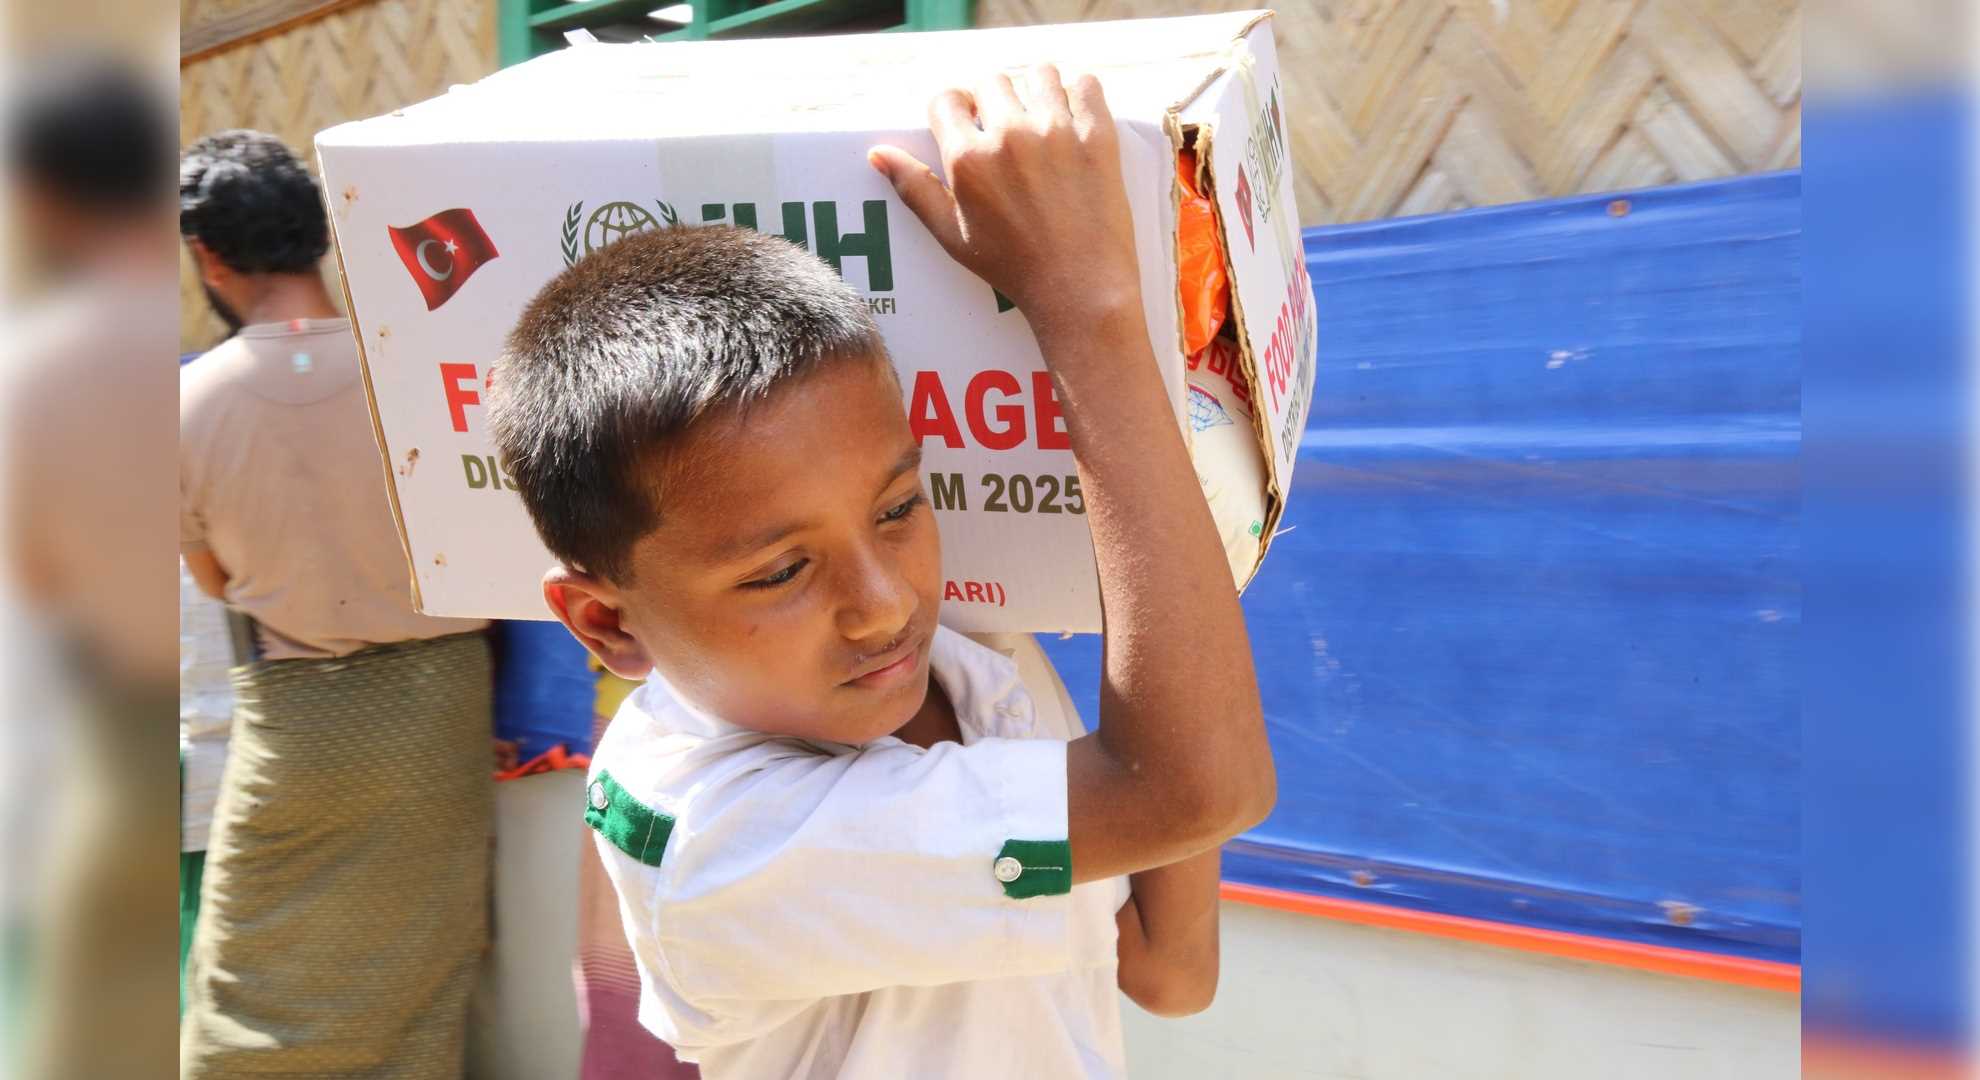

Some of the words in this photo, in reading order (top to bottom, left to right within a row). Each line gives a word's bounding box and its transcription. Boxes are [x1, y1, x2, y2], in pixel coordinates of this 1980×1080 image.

[860, 298, 896, 314] KFI
[1264, 302, 1295, 415] FOOD
[440, 363, 494, 432] F
[981, 473, 1087, 514] 2025
[944, 580, 1006, 607] ARI)
